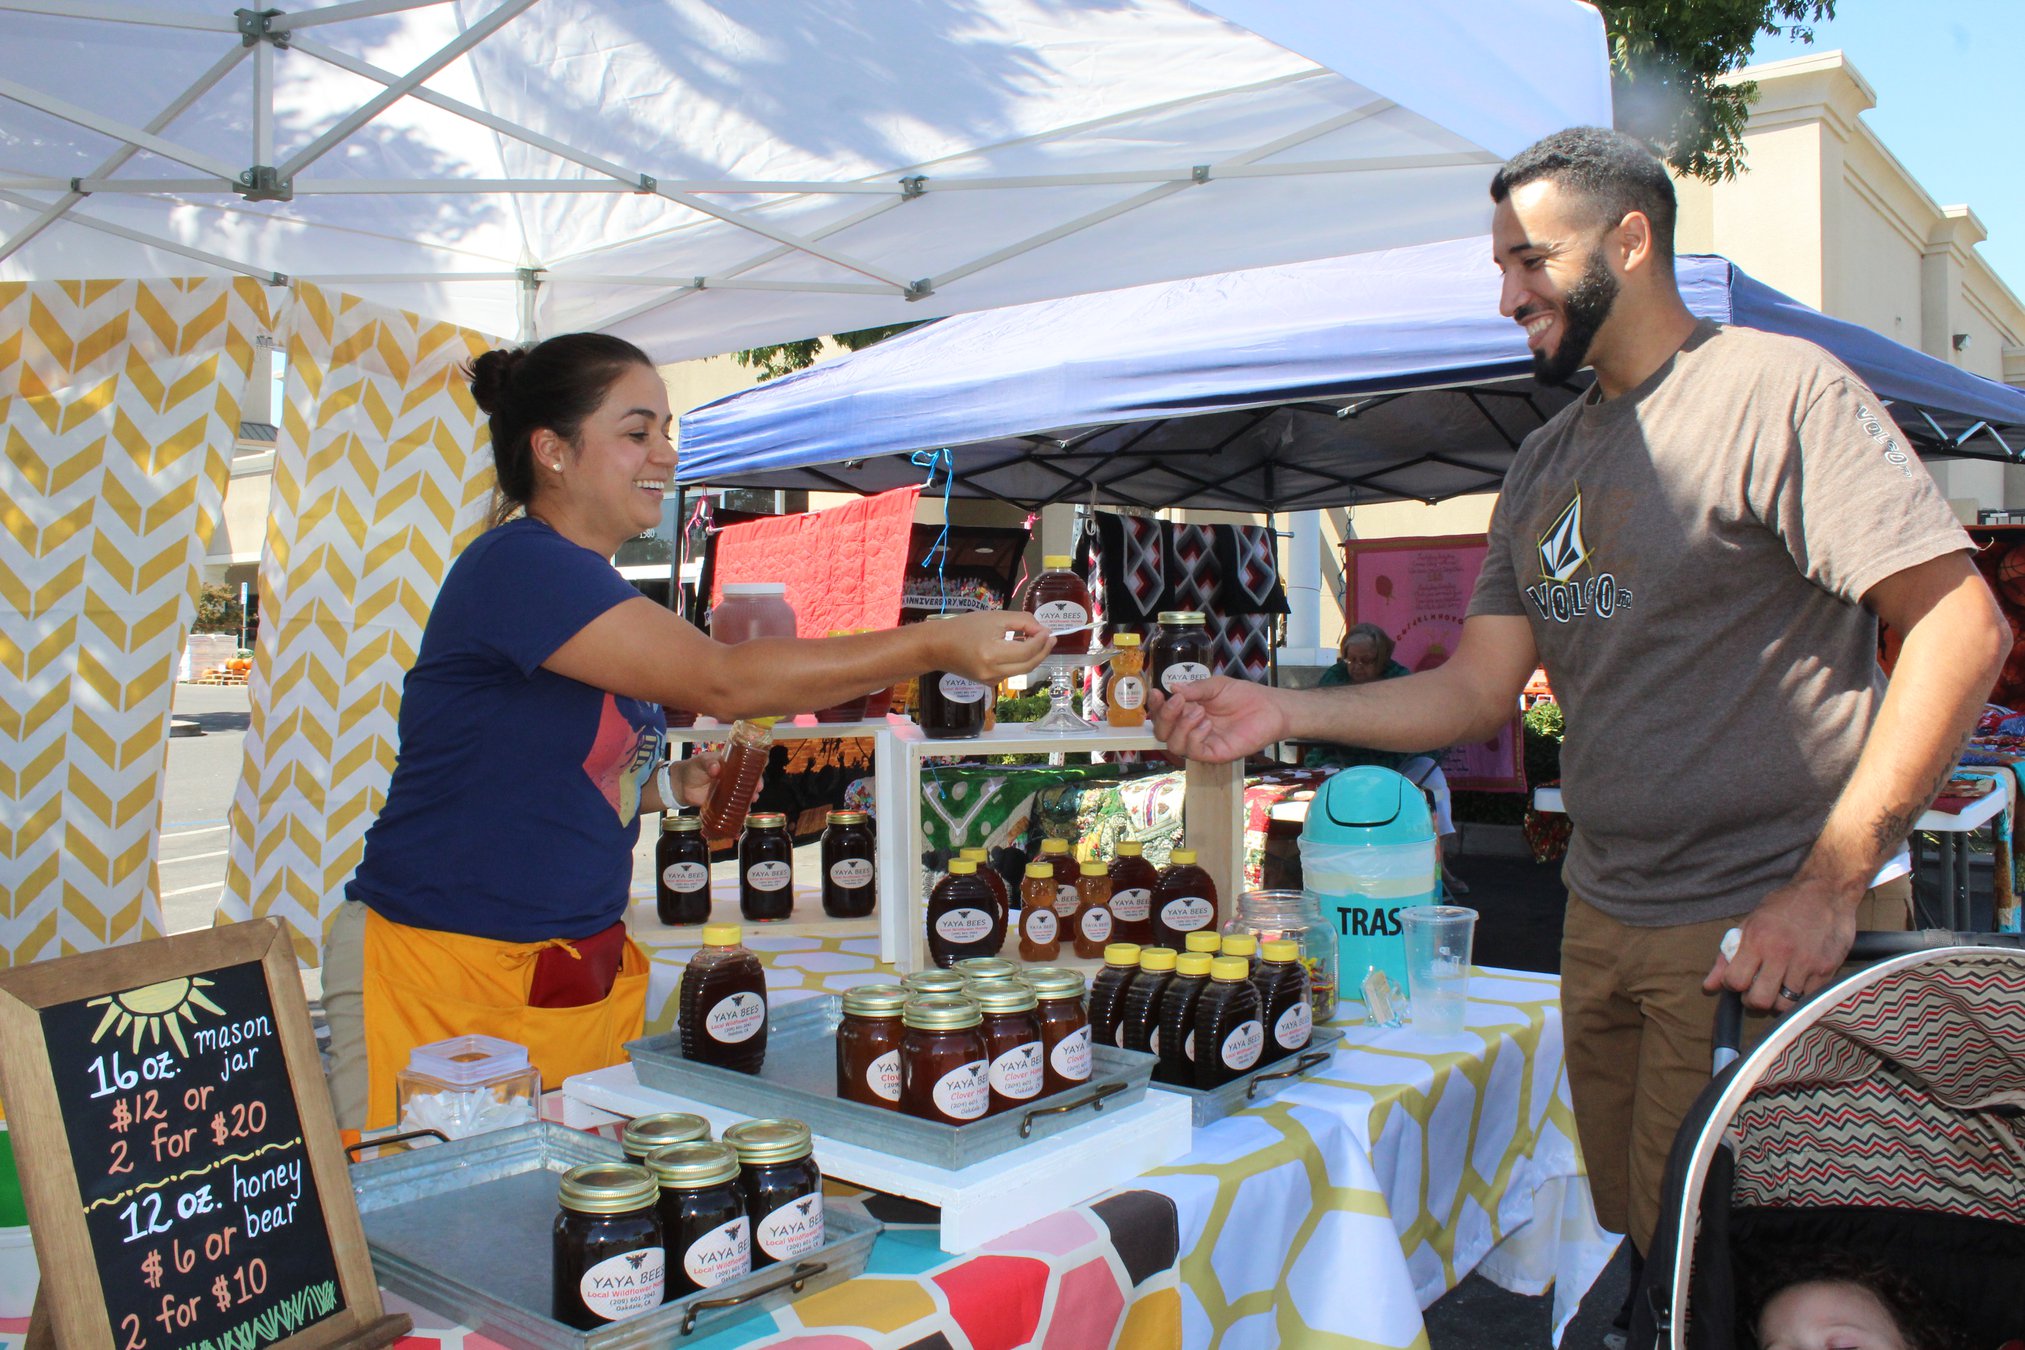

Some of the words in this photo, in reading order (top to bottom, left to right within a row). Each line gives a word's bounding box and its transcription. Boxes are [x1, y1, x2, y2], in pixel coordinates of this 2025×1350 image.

[966, 919, 986, 927] BEES
[1337, 905, 1412, 937] TRAS
[714, 1011, 738, 1022] YAYA
[740, 1004, 759, 1017] BEES
[1281, 1020, 1298, 1031] YAYA
[1063, 1043, 1085, 1055] YAYA
[1229, 1040, 1246, 1052] YAYA
[1248, 1033, 1260, 1045] BEES
[87, 1051, 139, 1098] 16
[143, 1049, 181, 1079] oz.
[194, 1016, 272, 1054] mason
[221, 1046, 259, 1082] jar
[1001, 1060, 1028, 1072] YAYA
[1030, 1055, 1042, 1067] BE
[877, 1063, 900, 1073] YAY
[1004, 1071, 1028, 1081] Clover
[881, 1074, 900, 1082] Clov
[946, 1079, 975, 1091] YAYA
[977, 1073, 989, 1086] BE
[950, 1090, 975, 1101] Clover
[109, 1088, 167, 1133] $12
[184, 1085, 215, 1112] or
[108, 1141, 134, 1175] 2
[151, 1122, 197, 1162] for
[211, 1101, 267, 1146] $20
[119, 1192, 173, 1243] 12
[177, 1184, 223, 1220] oz.
[233, 1158, 302, 1202] honey
[244, 1199, 297, 1239] bear
[769, 1221, 806, 1237] YAYA
[205, 1227, 238, 1261] or
[766, 1239, 786, 1247] Local
[698, 1247, 734, 1264] YAYA
[694, 1266, 714, 1275] Local
[593, 1275, 635, 1289] YAYA
[612, 1285, 652, 1297] Wildflower
[120, 1313, 146, 1350] 2
[156, 1294, 201, 1334] for
[211, 1258, 267, 1312] $10
[610, 1297, 629, 1306] (209)
